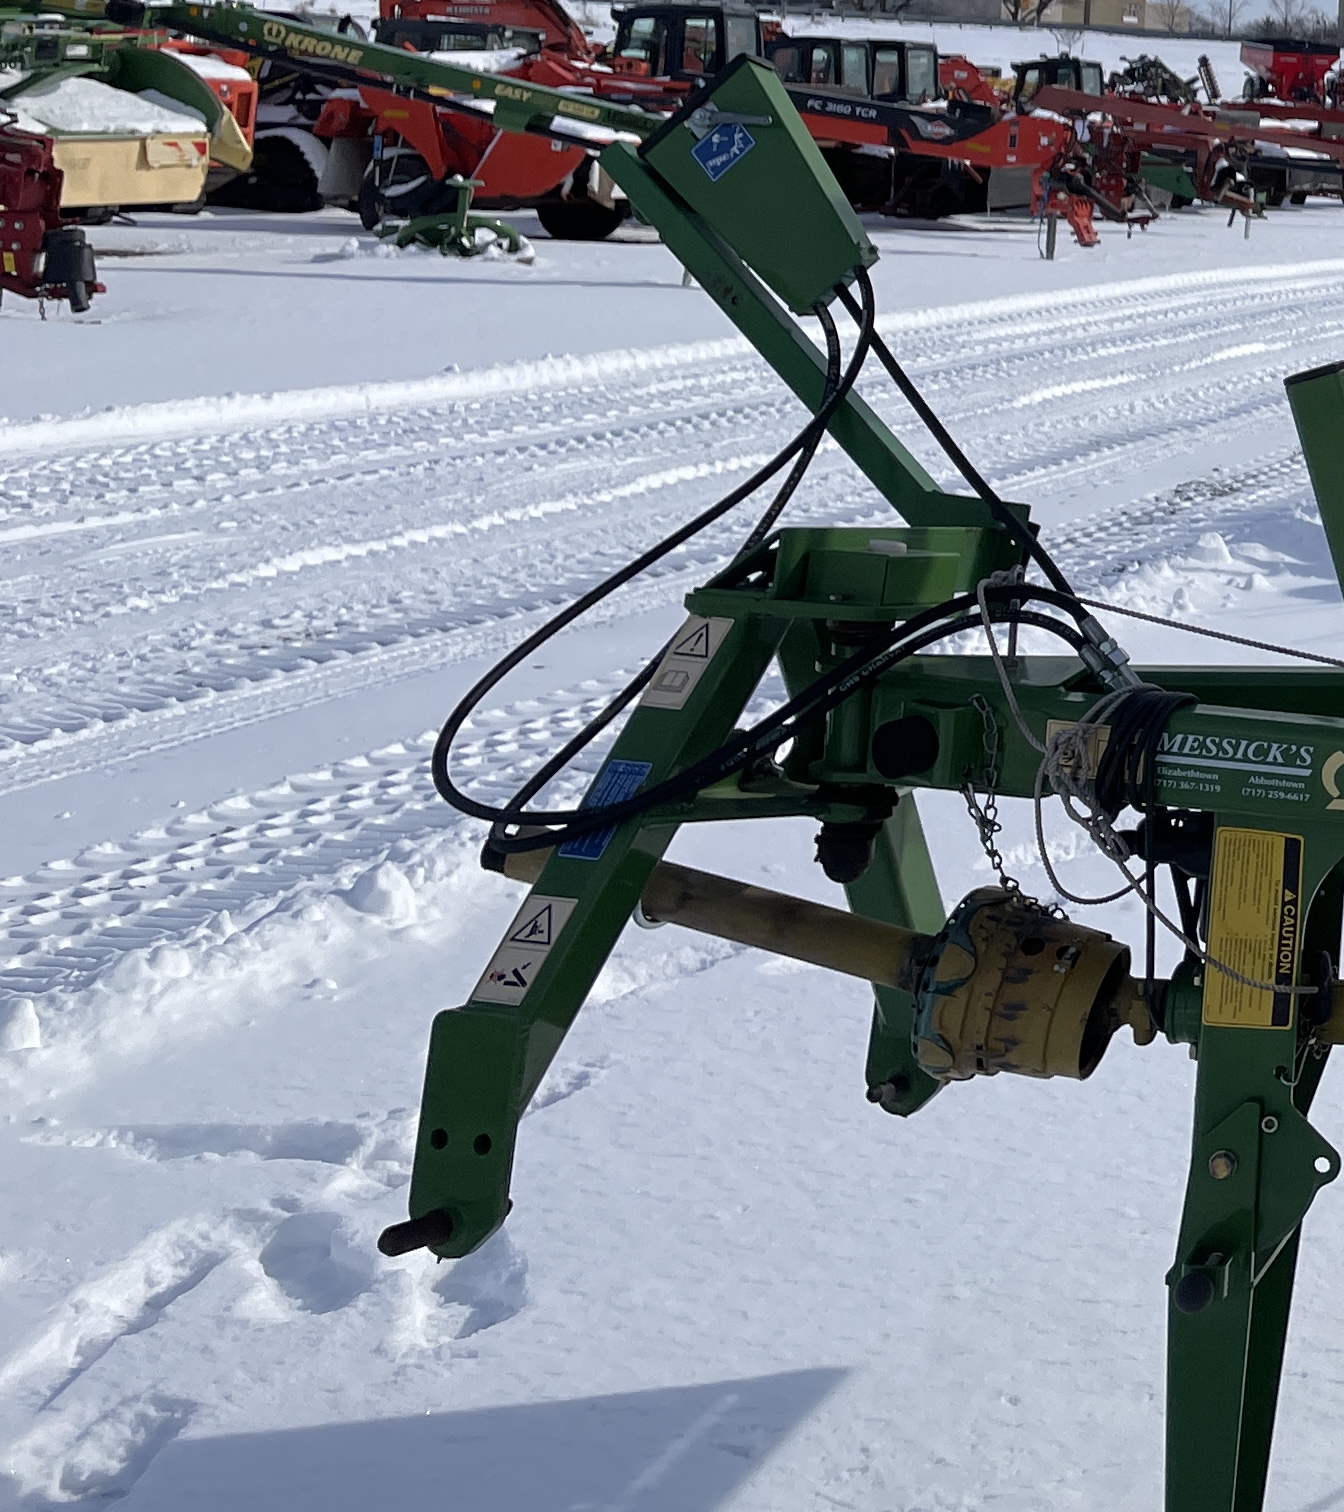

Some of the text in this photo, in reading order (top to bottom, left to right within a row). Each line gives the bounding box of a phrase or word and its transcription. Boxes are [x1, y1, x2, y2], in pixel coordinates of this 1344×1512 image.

[285, 32, 363, 65] KRONE
[1156, 732, 1314, 767] MESSICK'S
[1156, 766, 1219, 781] Elizabethtown
[1248, 775, 1305, 790] Abbottstown
[1241, 787, 1311, 803] (717) 259-6617
[1278, 904, 1296, 974] CAUTION
